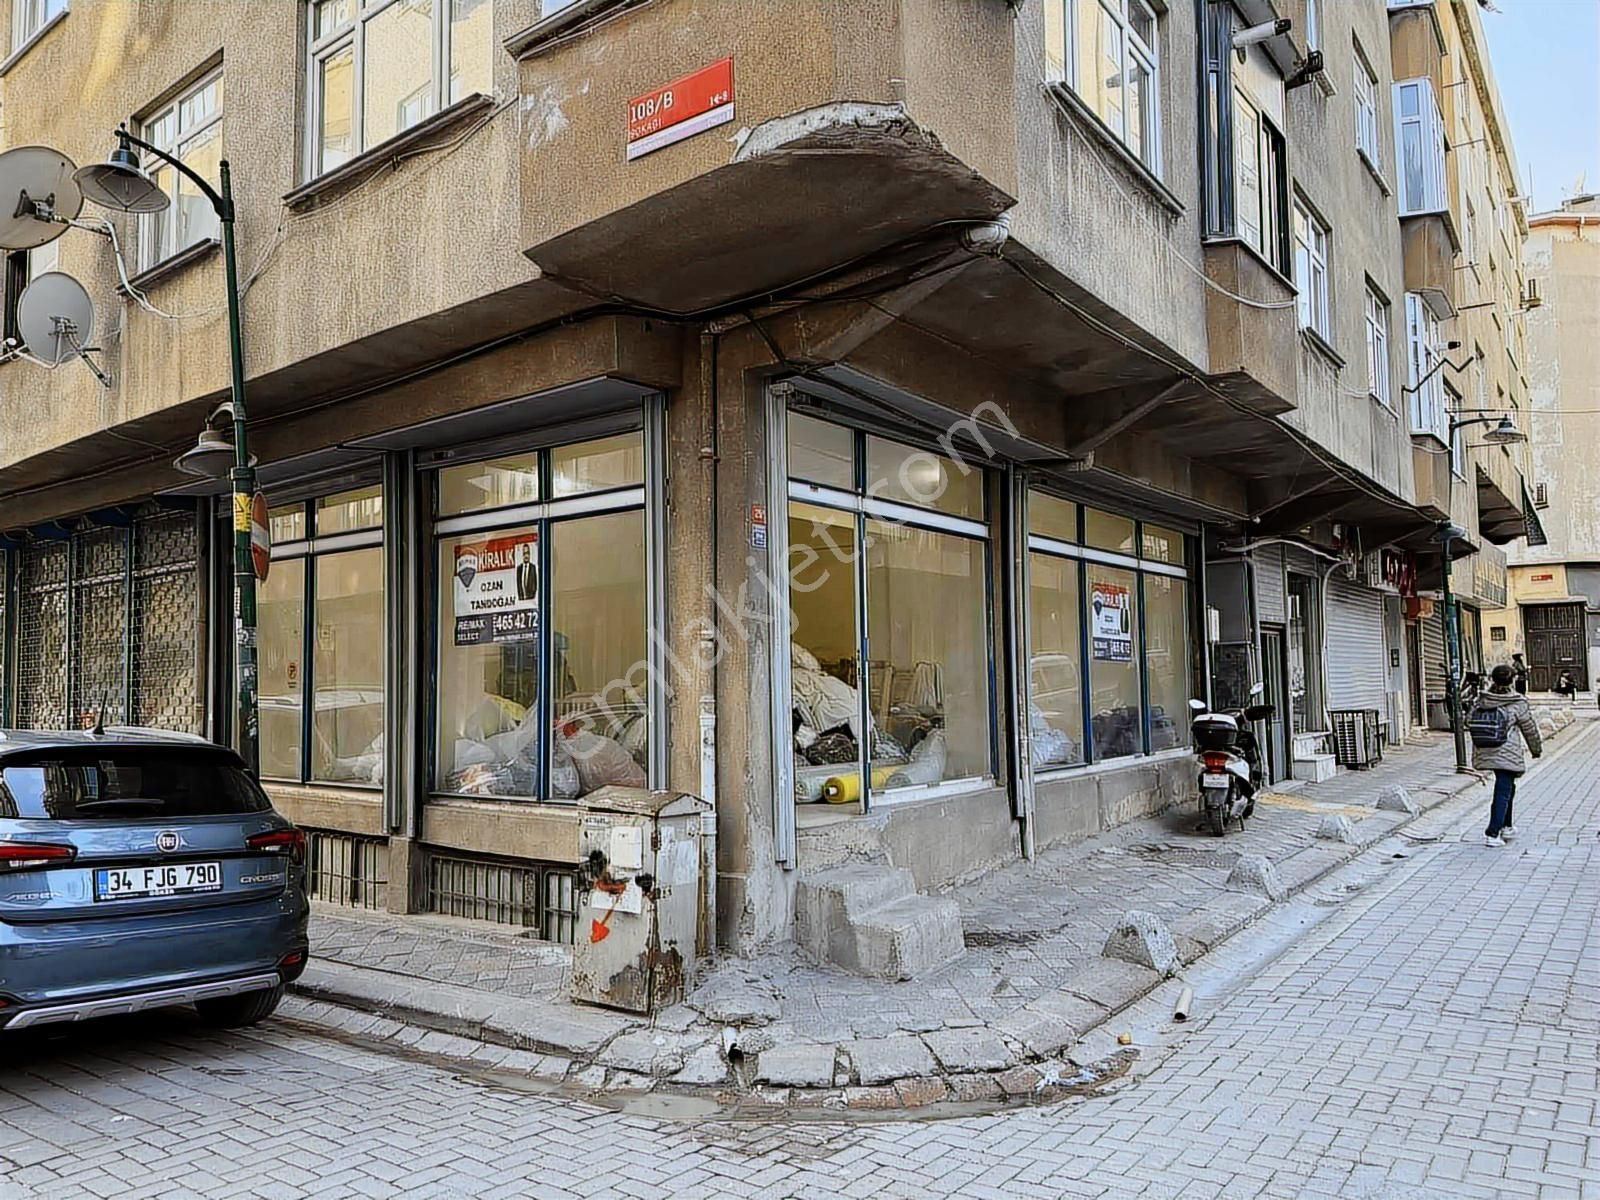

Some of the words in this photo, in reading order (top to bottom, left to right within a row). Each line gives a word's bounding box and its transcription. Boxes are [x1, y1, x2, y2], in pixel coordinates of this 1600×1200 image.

[630, 91, 673, 123] 108/B
[478, 548, 514, 570] KİRALIK
[480, 580, 503, 592] OZAN
[514, 612, 526, 629] 42
[527, 611, 539, 628] 72
[110, 870, 133, 891] 34
[144, 867, 177, 888] FJG
[185, 864, 217, 885] 790
